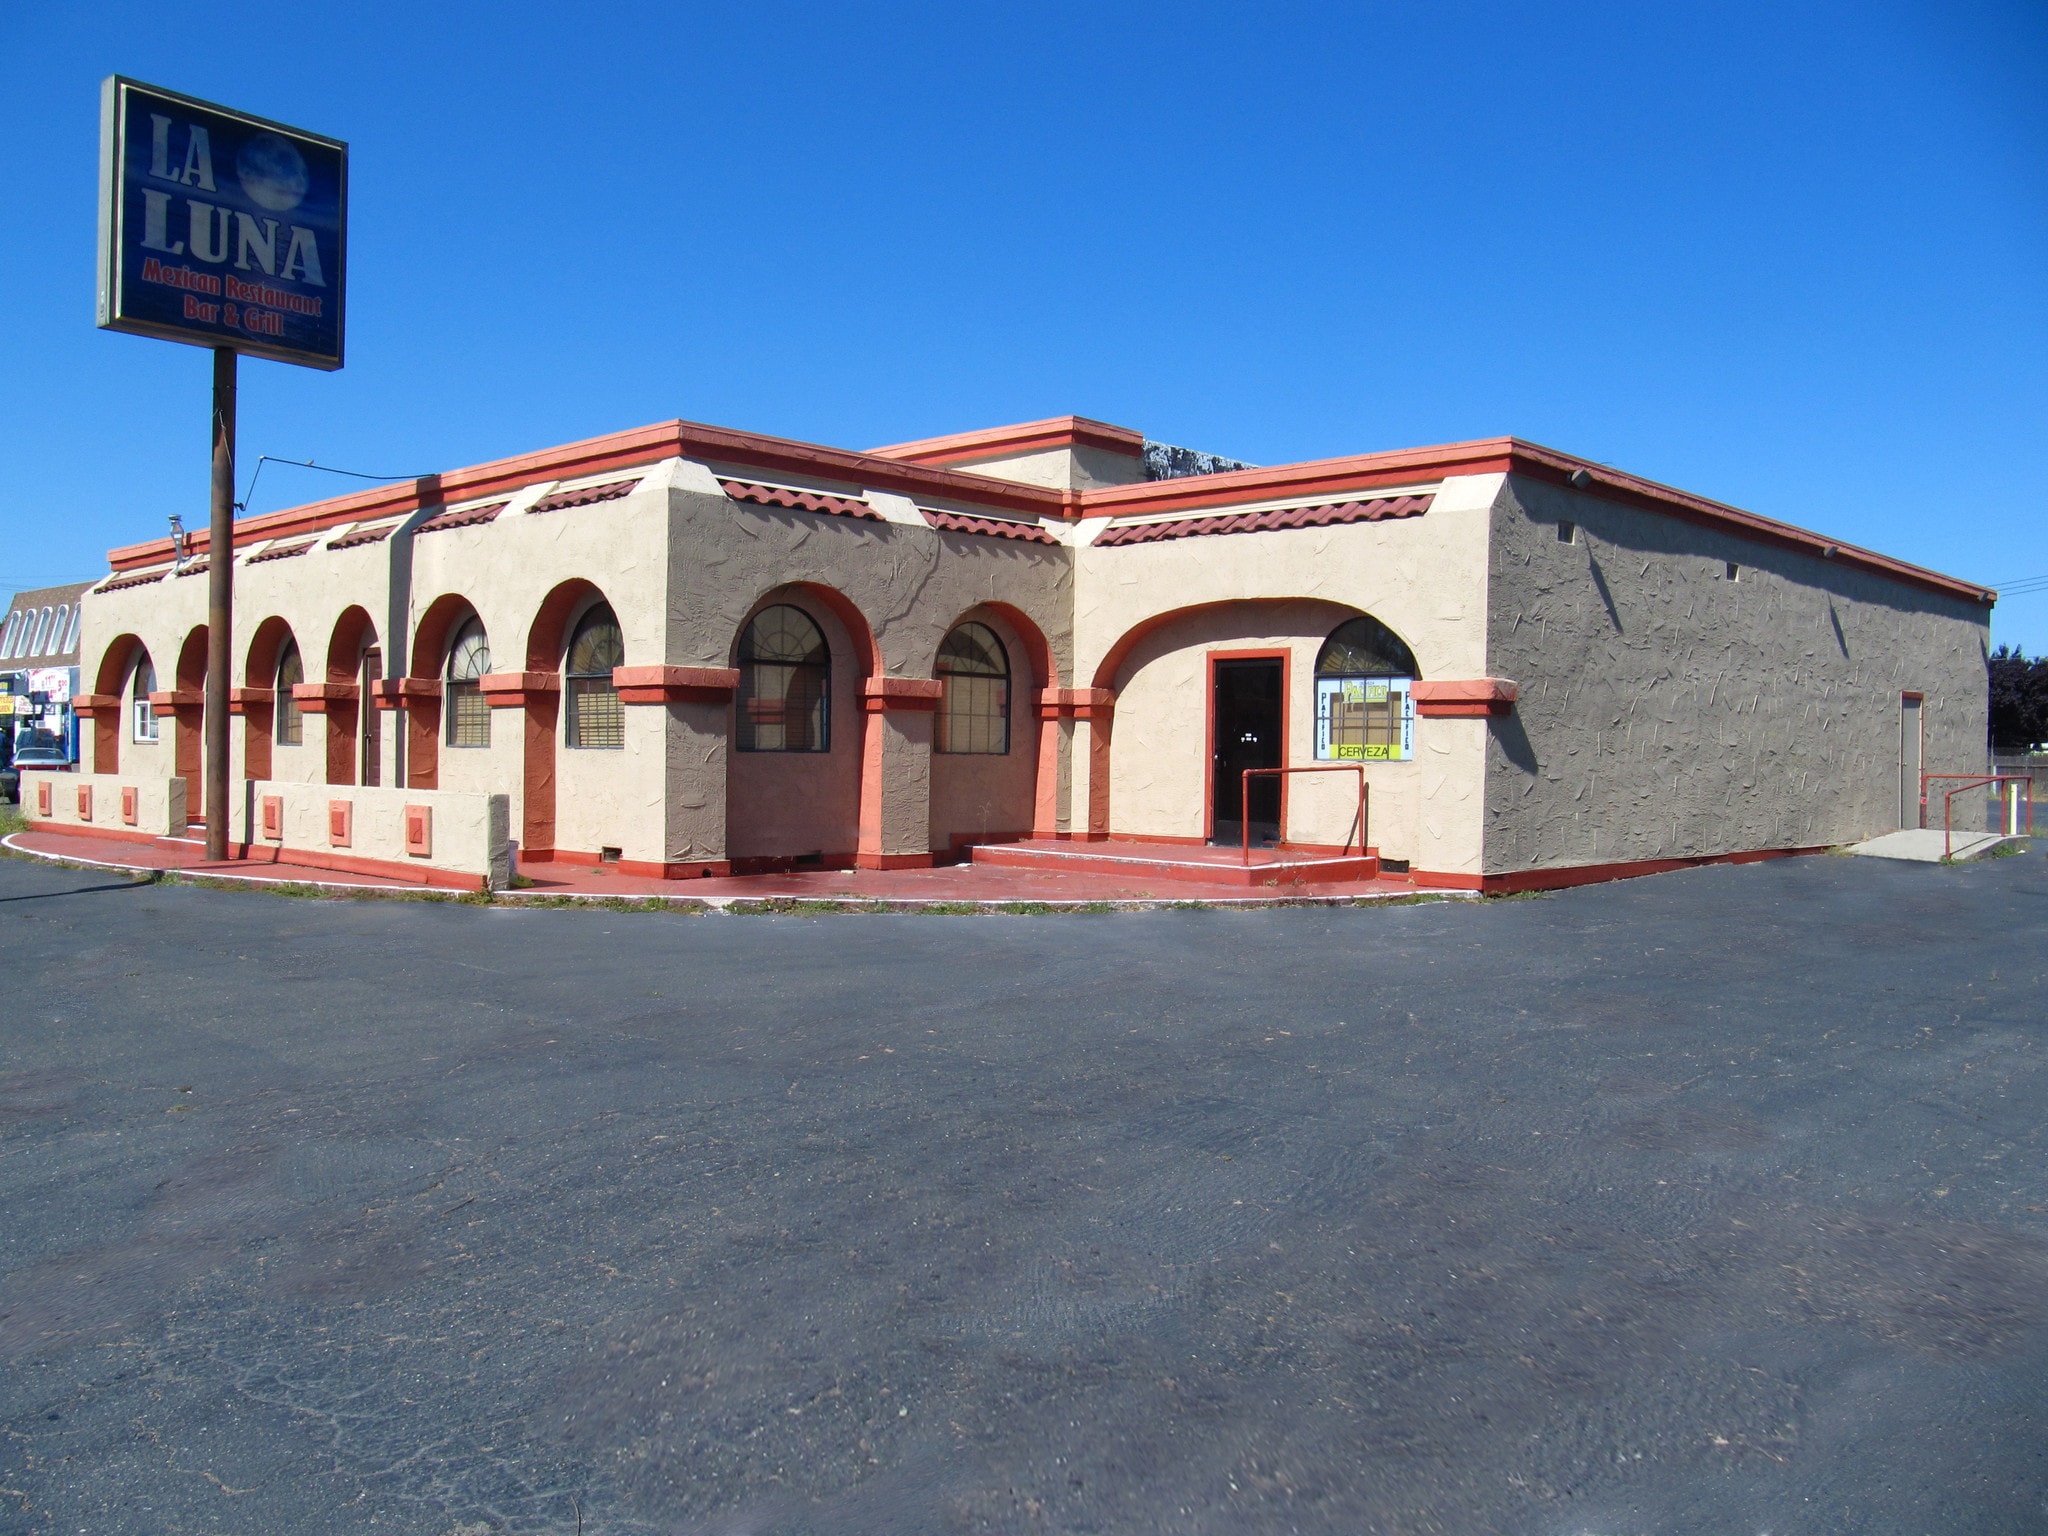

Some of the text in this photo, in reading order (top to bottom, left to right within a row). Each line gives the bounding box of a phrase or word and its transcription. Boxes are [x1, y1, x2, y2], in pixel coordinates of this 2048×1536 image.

[149, 113, 217, 192] LA
[140, 188, 327, 287] LUNA
[142, 257, 323, 317] Mexican Restaurant
[184, 295, 285, 336] Bar & Grill
[1343, 681, 1388, 703] PACFICO
[1338, 746, 1389, 757] CERVEZA
